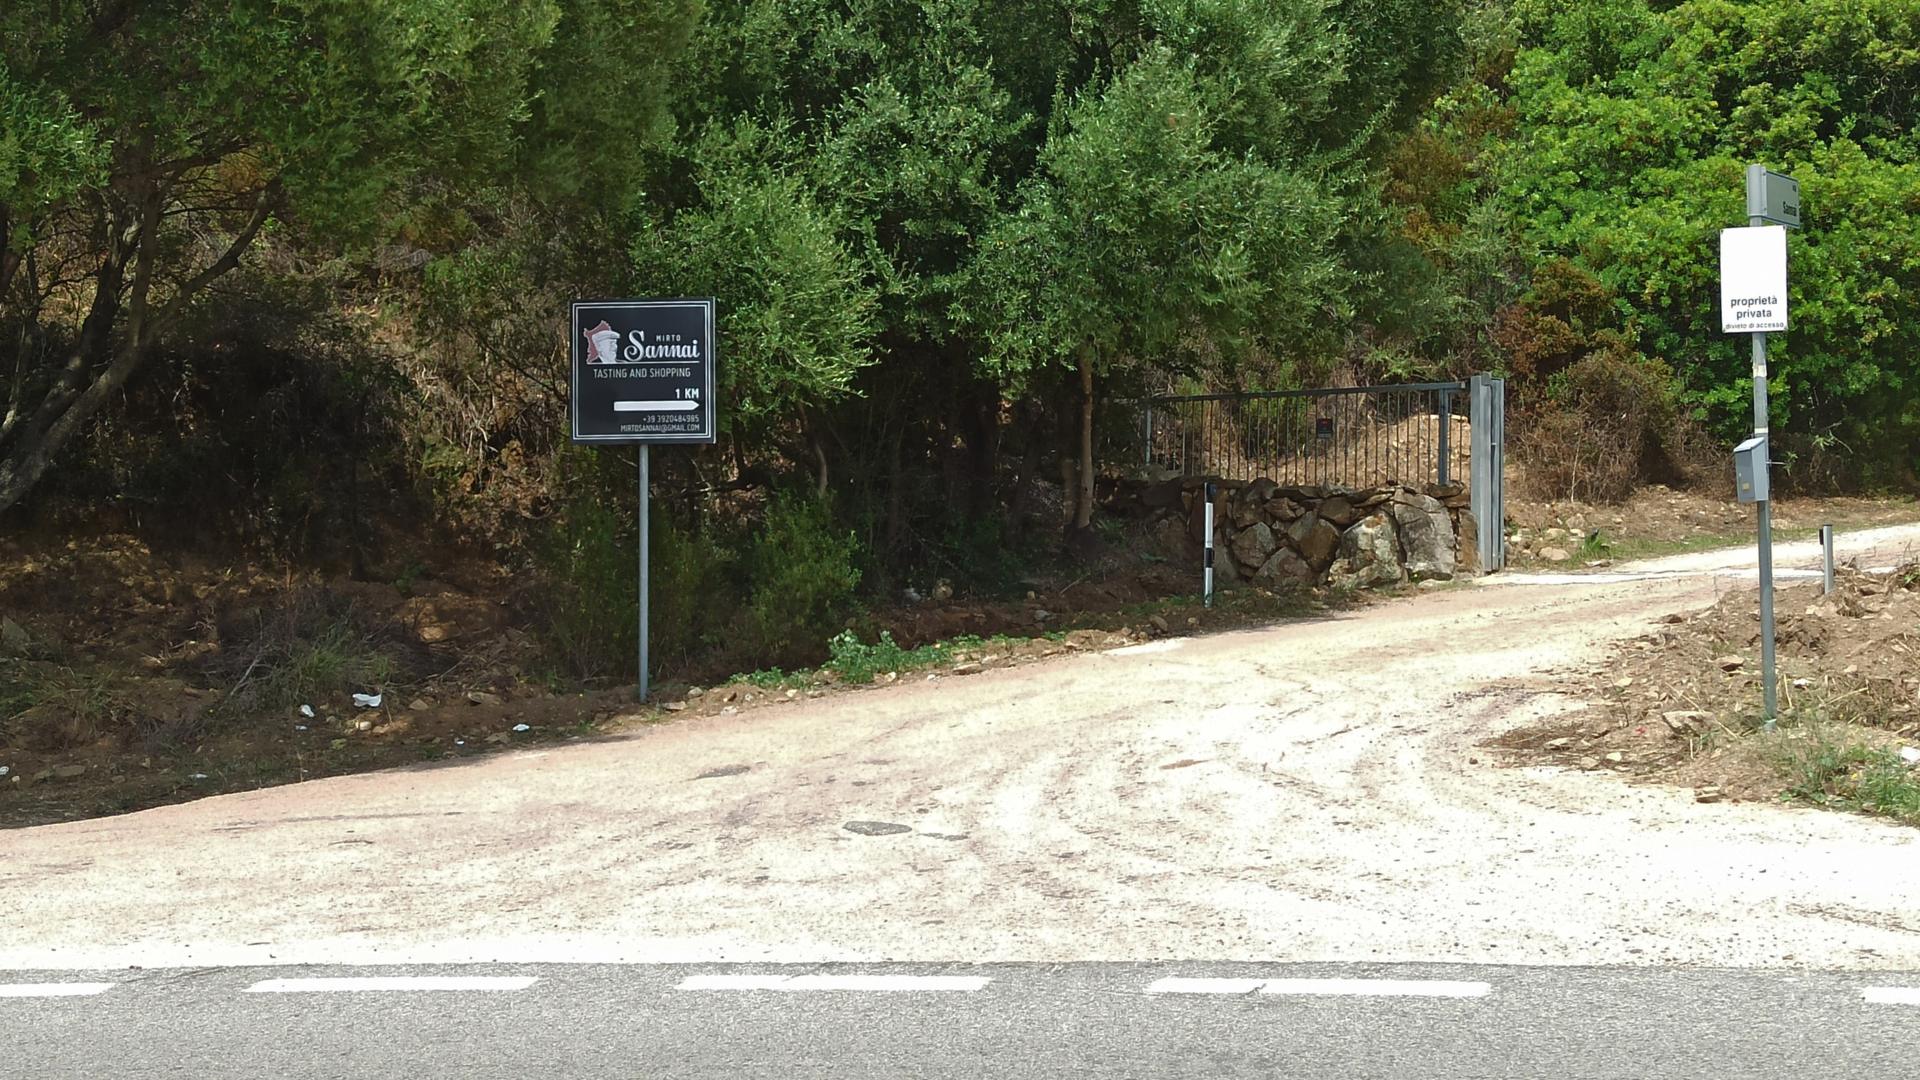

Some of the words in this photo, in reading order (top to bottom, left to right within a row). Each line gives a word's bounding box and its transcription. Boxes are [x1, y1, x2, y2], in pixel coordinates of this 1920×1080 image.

[1731, 295, 1778, 309] proprietà
[1736, 309, 1772, 320] privata
[656, 334, 681, 342] MIRTO
[624, 330, 700, 362] Sannai
[593, 368, 628, 379] TASTING
[629, 368, 647, 378] AND
[649, 367, 691, 378] SHOPPING
[675, 388, 680, 399] 1
[684, 388, 699, 399] KM
